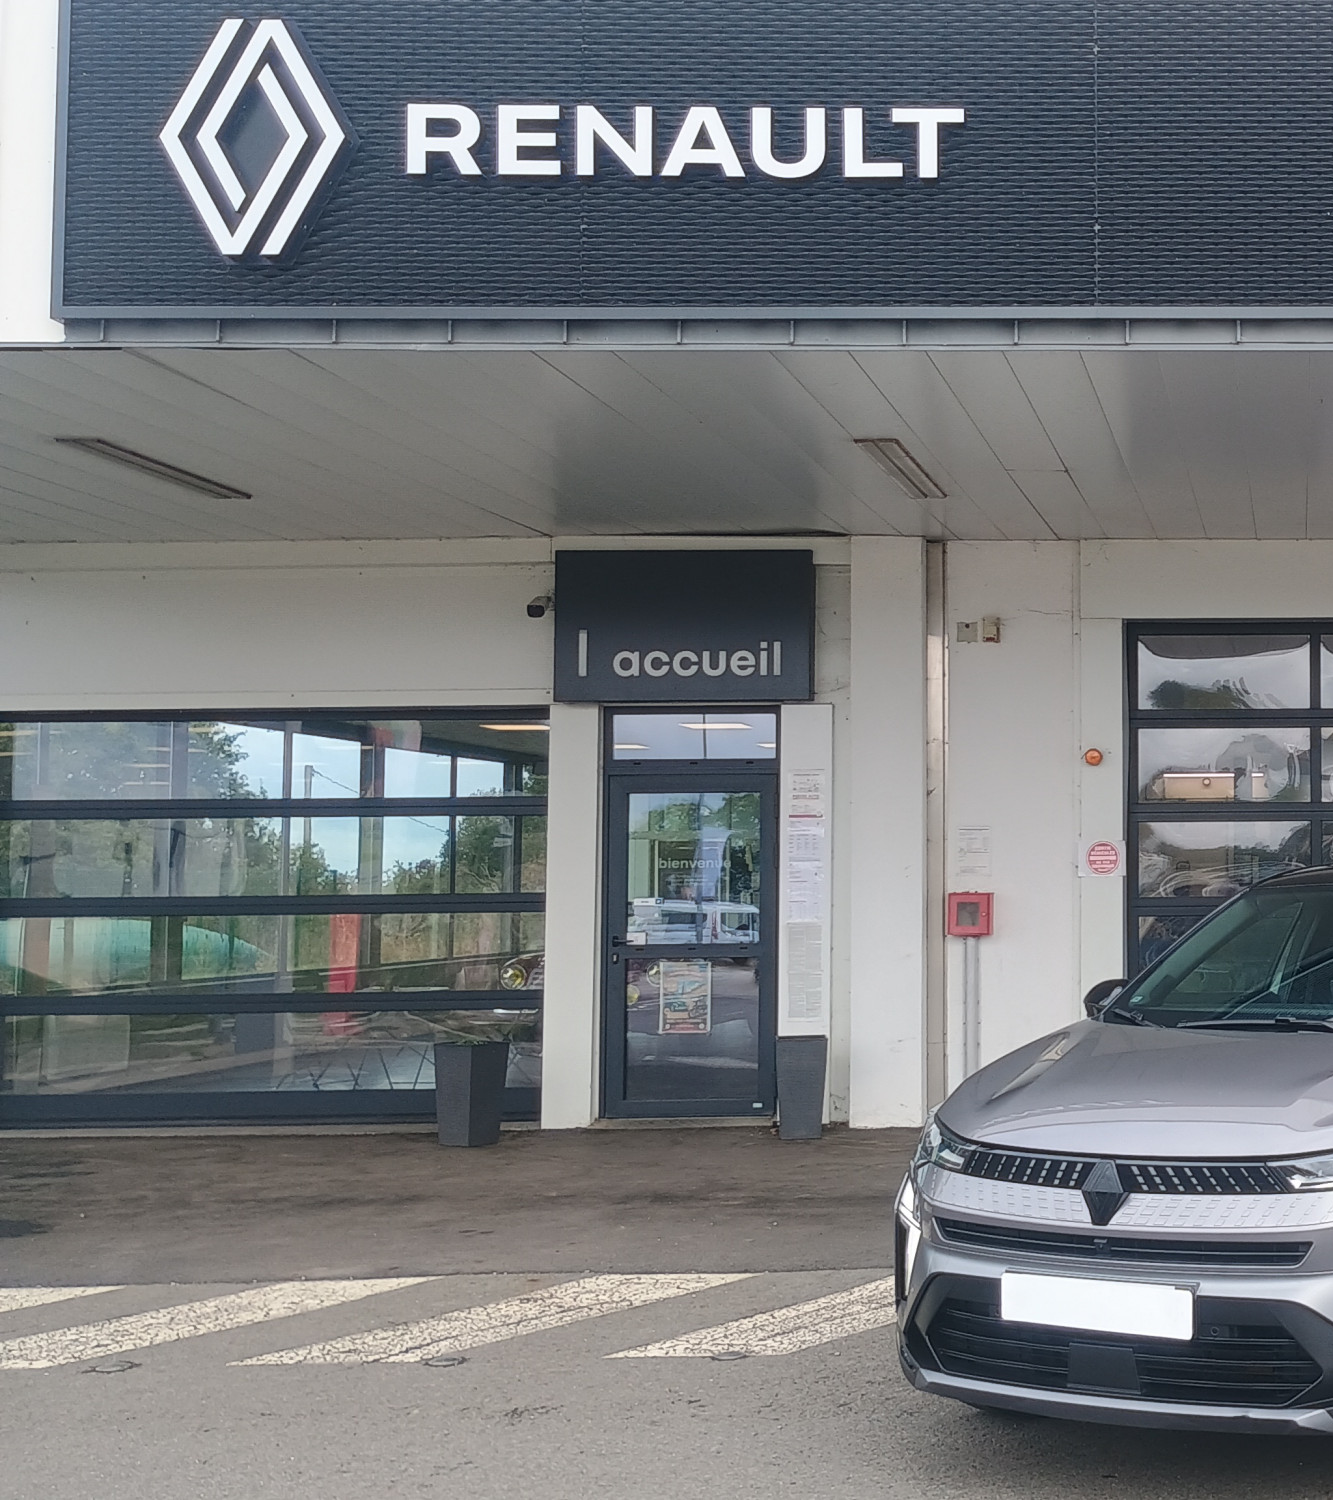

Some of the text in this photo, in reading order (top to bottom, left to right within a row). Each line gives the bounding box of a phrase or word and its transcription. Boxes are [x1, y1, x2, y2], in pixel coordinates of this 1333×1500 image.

[405, 103, 965, 179] RENAULT
[612, 641, 782, 678] accueil
[658, 857, 732, 870] bienvenue
